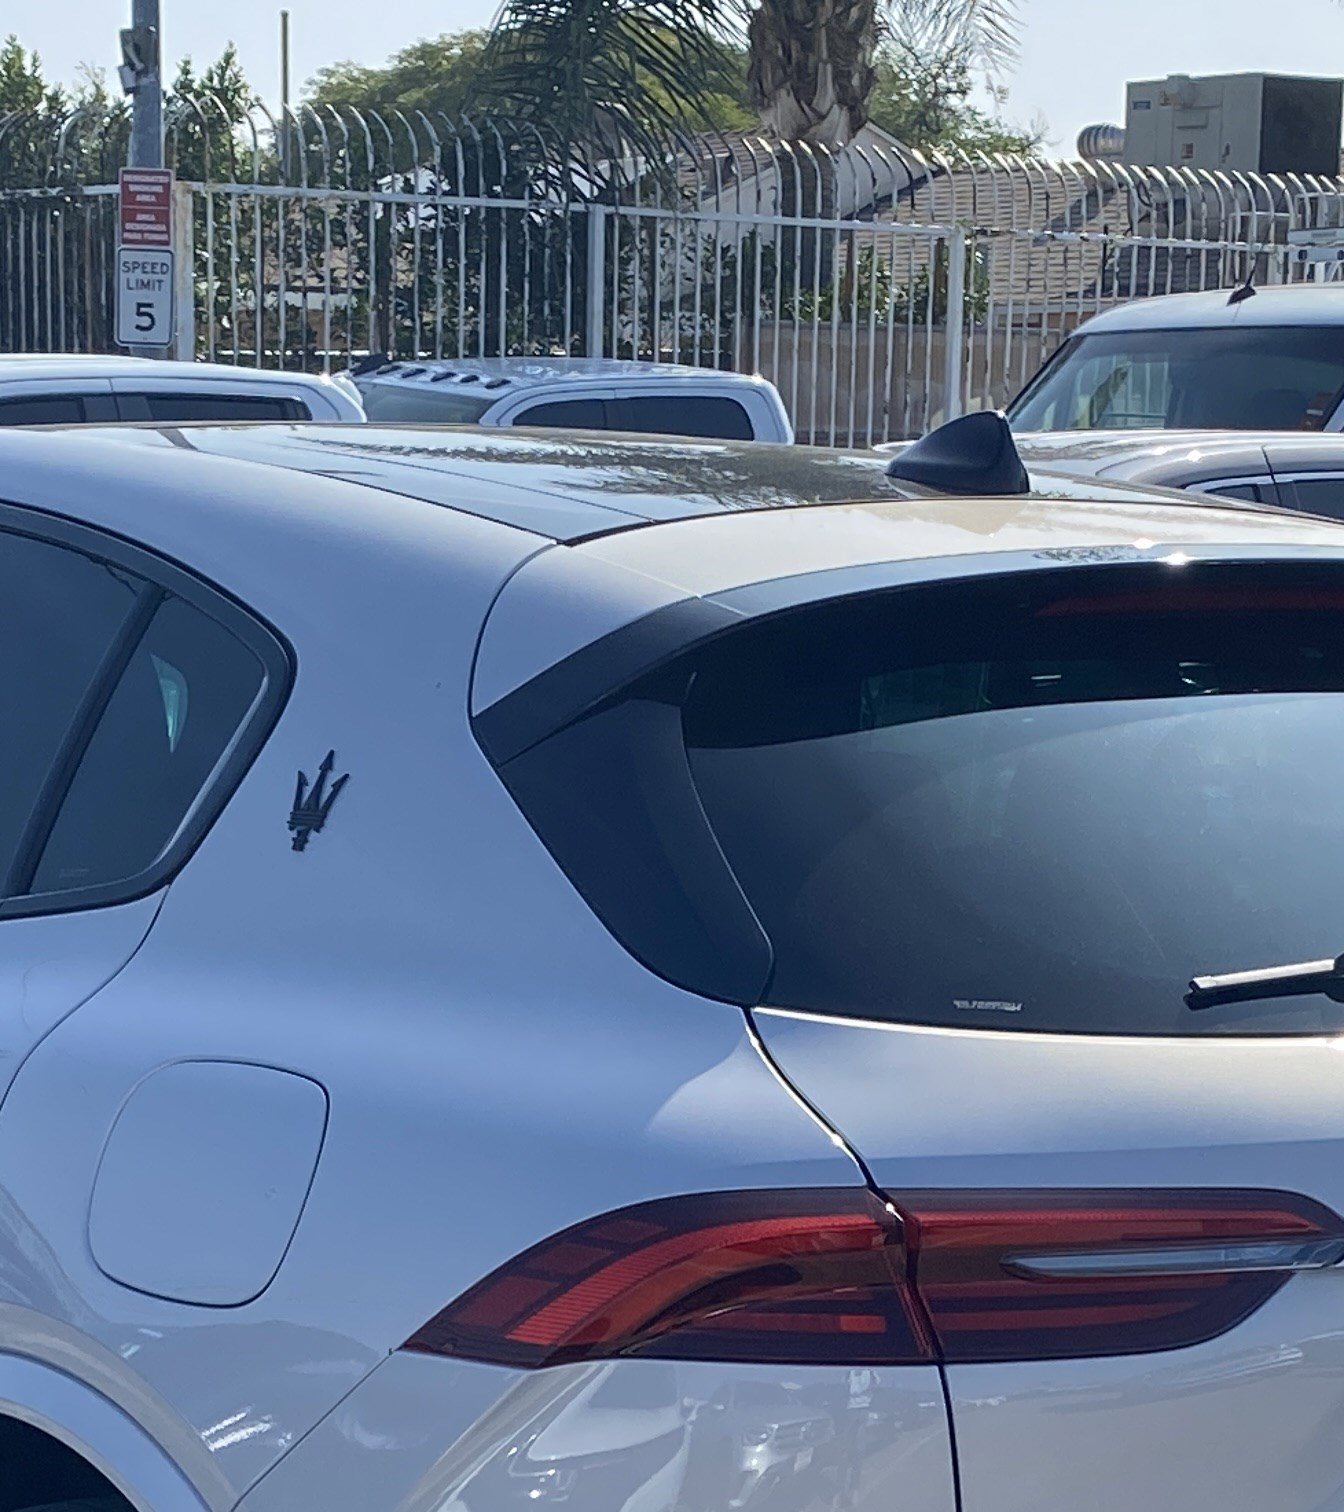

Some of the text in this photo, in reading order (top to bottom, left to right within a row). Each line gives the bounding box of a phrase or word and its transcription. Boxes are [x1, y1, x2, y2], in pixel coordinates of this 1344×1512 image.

[121, 260, 170, 275] SPEED
[125, 278, 165, 292] LIMIT
[134, 302, 156, 332] 5
